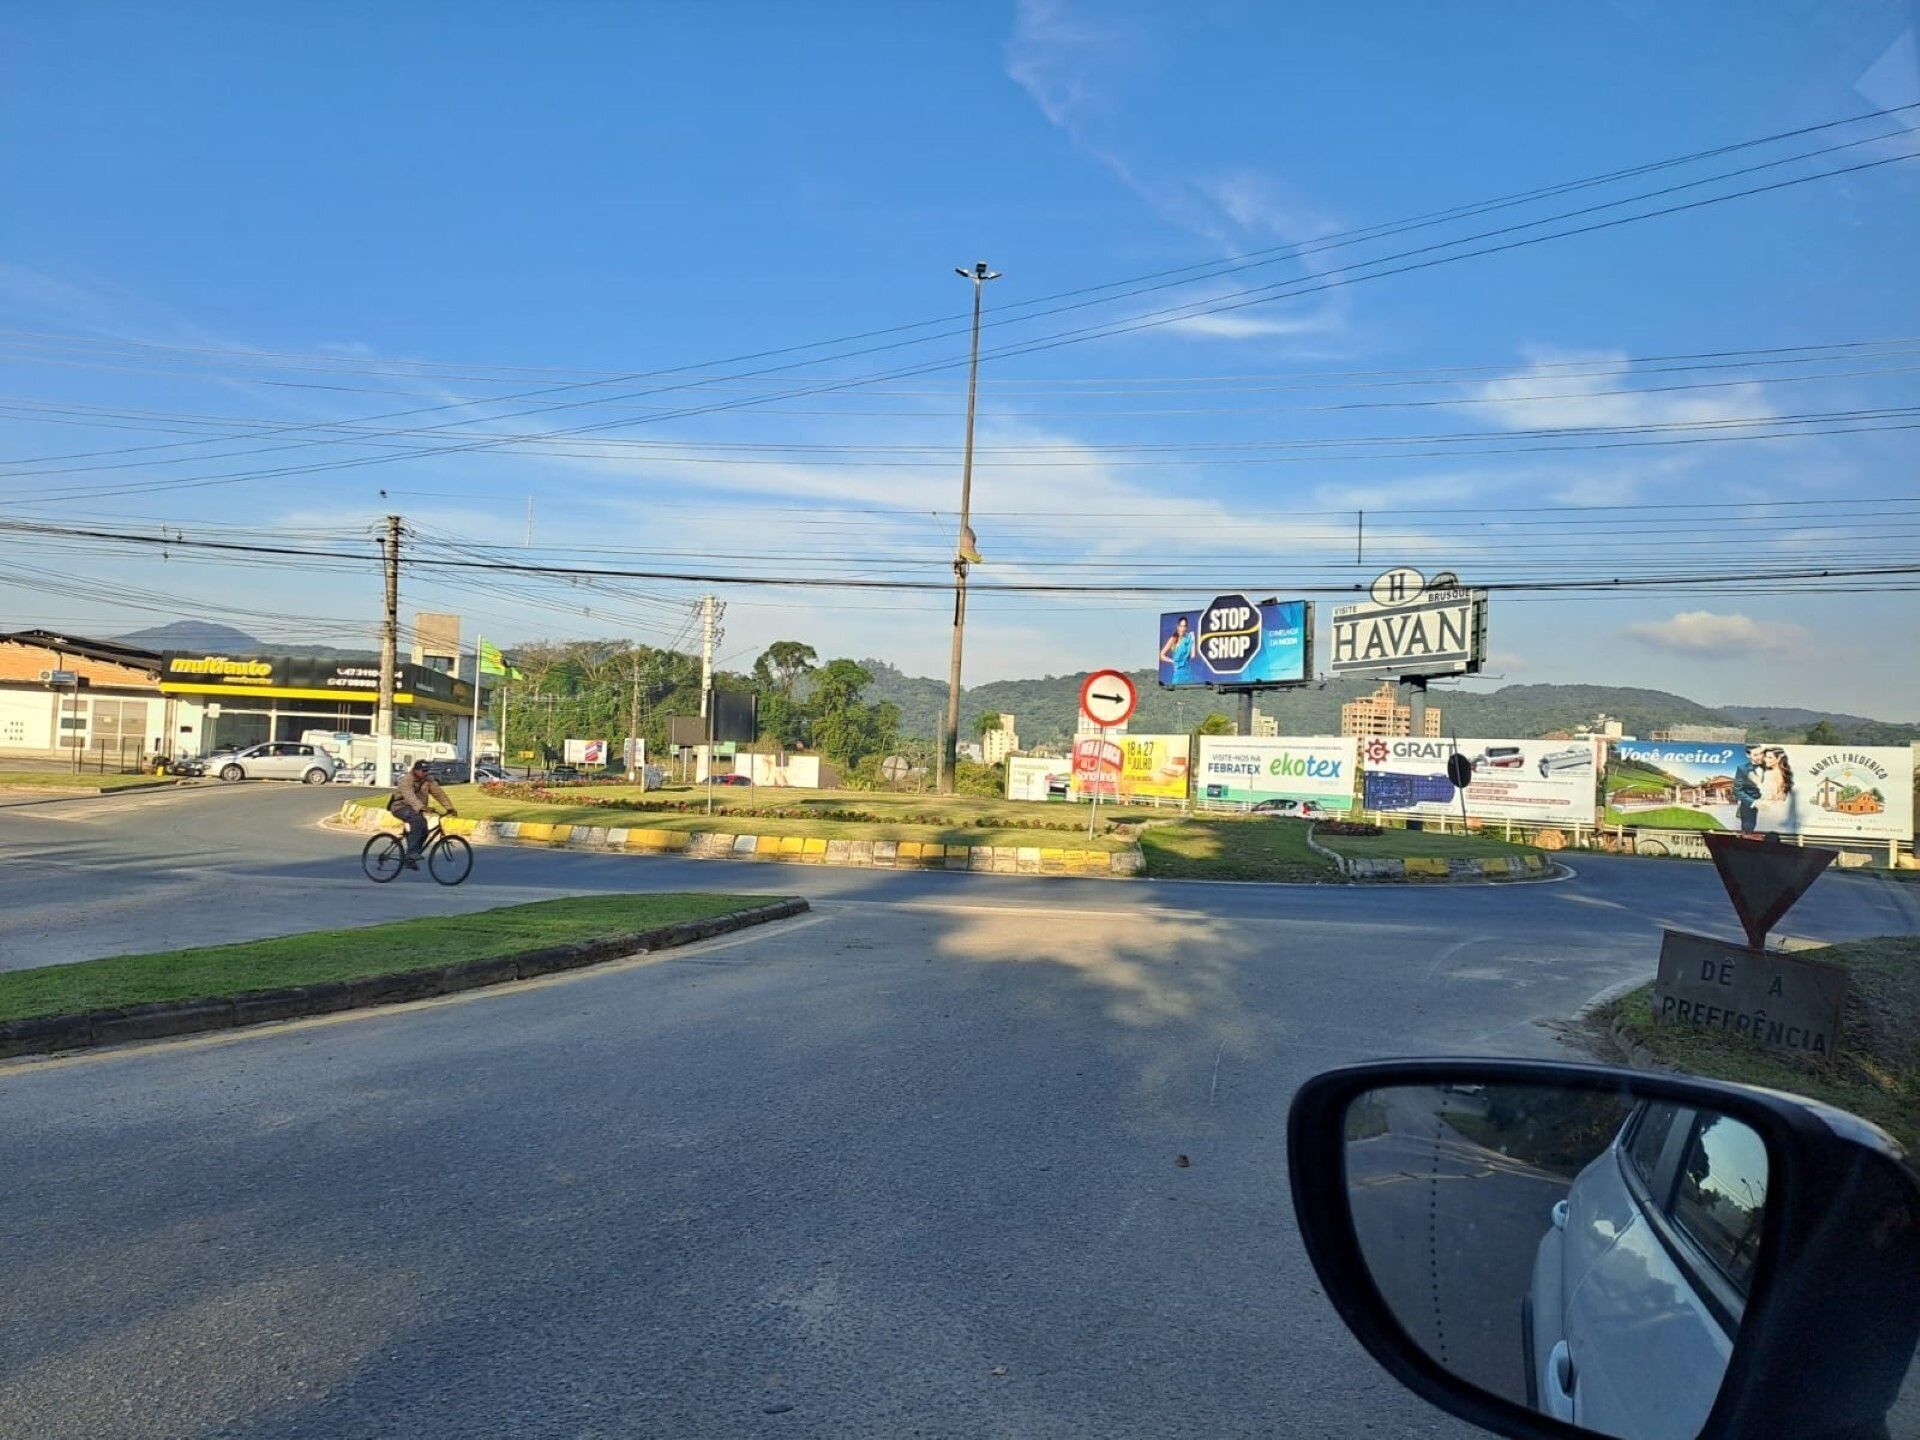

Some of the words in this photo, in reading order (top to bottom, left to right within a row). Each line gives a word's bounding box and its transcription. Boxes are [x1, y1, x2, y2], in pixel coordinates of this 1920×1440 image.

[1388, 572, 1406, 601] H
[1209, 607, 1250, 632] STOP
[1334, 606, 1358, 615] VISITE
[1332, 607, 1470, 662] HAVAN
[1208, 636, 1250, 660] SHOP
[169, 656, 272, 676] multiauto
[1127, 741, 1136, 756] 18
[1143, 741, 1154, 756] 27
[1212, 753, 1249, 762] VISITE-NOS
[1393, 743, 1460, 758] GRATT
[1620, 747, 1660, 760] Você
[1662, 749, 1733, 764] aceita?
[1207, 763, 1261, 776] FEBRATEX
[1269, 752, 1342, 777] ekotex
[1809, 754, 1840, 776] MONTE
[1842, 752, 1889, 780] FREDERICO
[1701, 956, 1735, 986] DÊ
[1769, 976, 1783, 998] A
